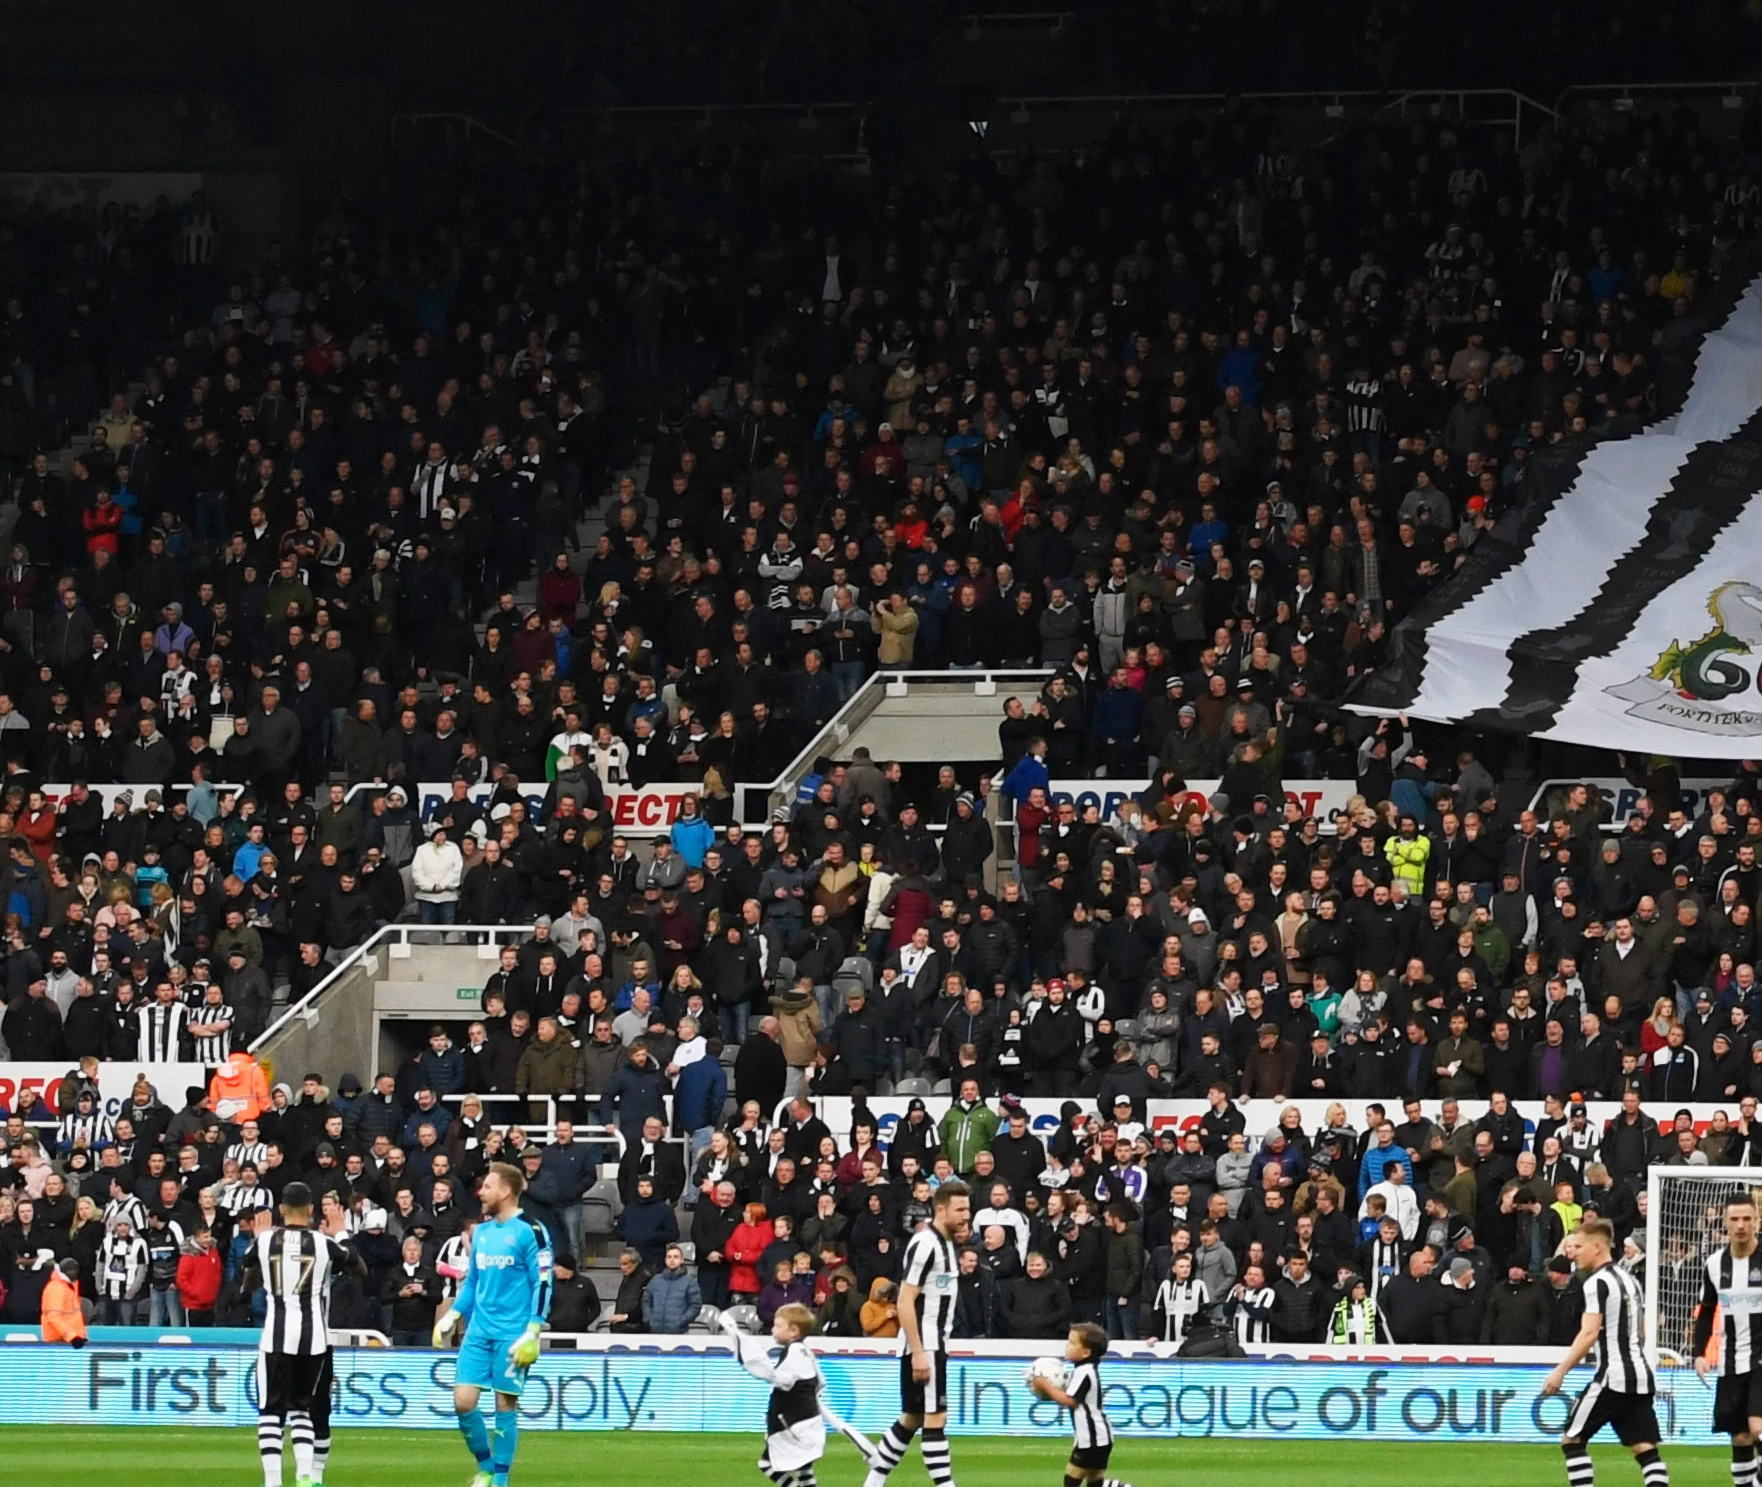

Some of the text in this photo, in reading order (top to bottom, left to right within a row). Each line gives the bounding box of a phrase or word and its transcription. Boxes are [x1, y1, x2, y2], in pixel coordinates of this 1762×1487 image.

[269, 1254, 316, 1295] 17
[90, 1351, 227, 1413] First
[959, 1366, 1010, 1425] In
[1102, 1382, 1298, 1438] eague
[1317, 1370, 1389, 1433] of
[1401, 1387, 1516, 1434] our
